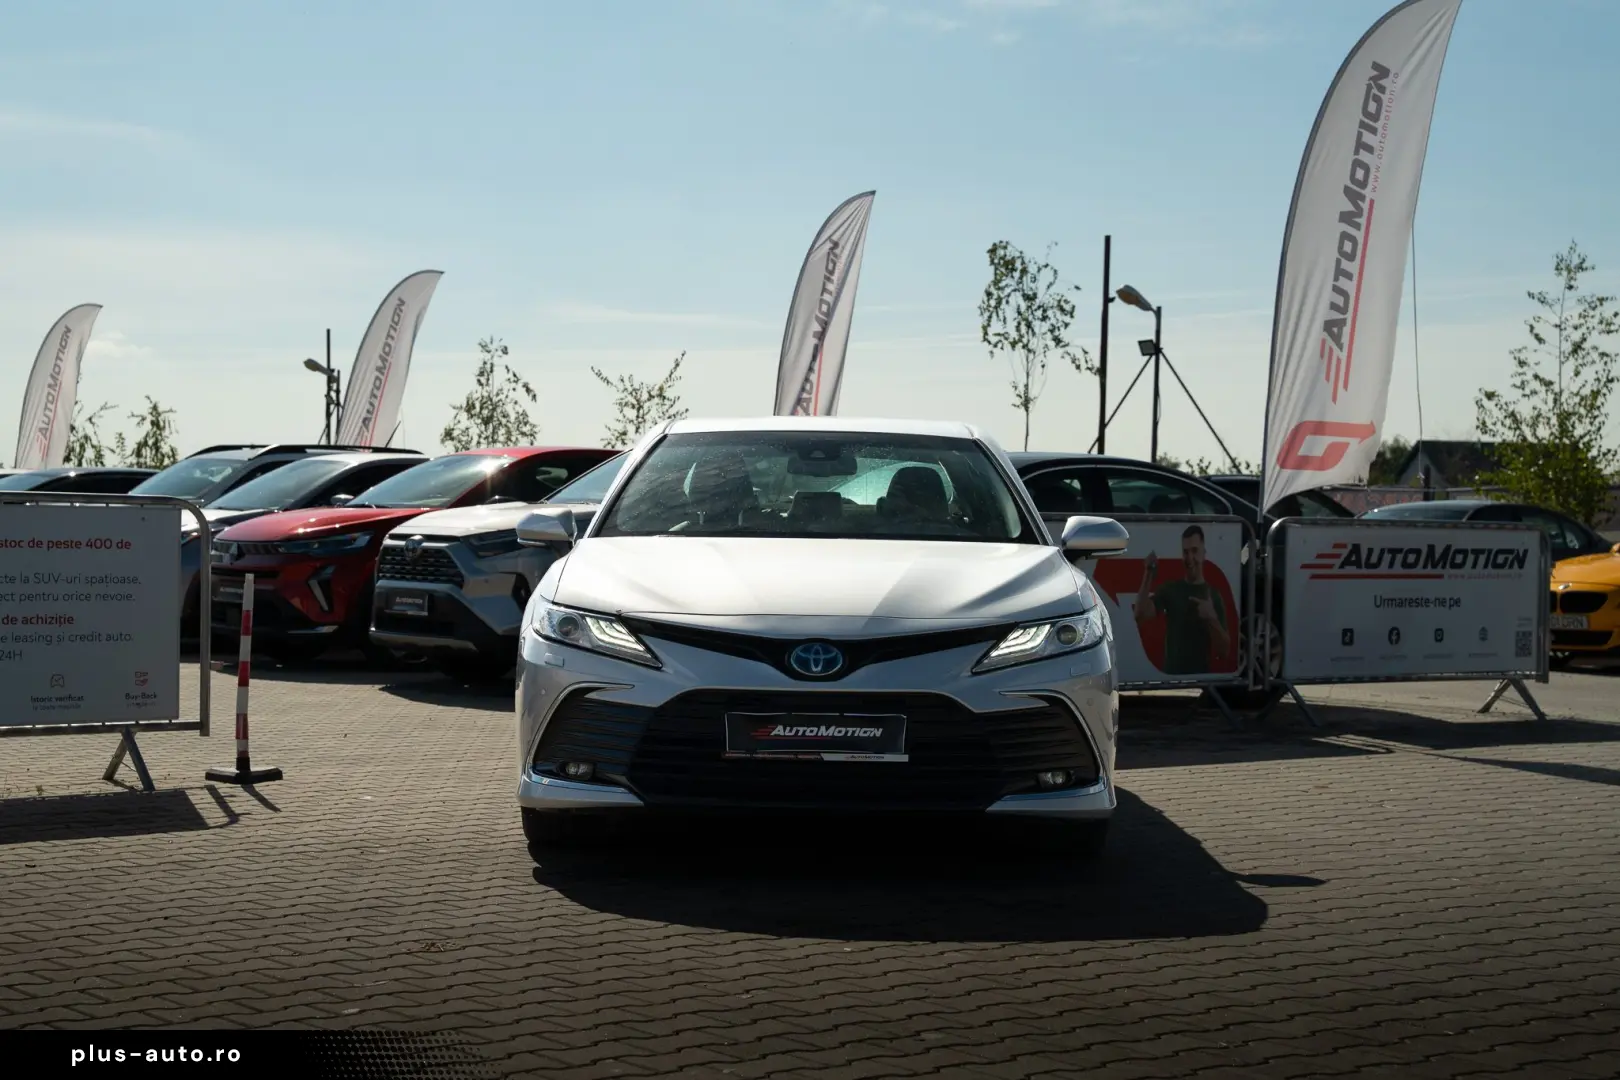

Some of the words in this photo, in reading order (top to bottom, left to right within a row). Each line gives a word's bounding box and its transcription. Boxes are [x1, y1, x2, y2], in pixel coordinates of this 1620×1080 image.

[1370, 71, 1400, 193] www.automotion.ro
[799, 236, 840, 416] AUMOTION
[0, 538, 24, 549] stoc
[27, 537, 43, 549] de
[47, 539, 82, 552] peste
[85, 538, 112, 549] 400
[116, 538, 132, 549] de
[20, 571, 30, 584] la
[33, 572, 81, 584] SUV-uri
[19, 591, 59, 604] pentru
[62, 590, 91, 602] orice
[95, 591, 136, 602] nevoie.
[1449, 597, 1461, 610] pe
[2, 613, 18, 625] de
[22, 613, 75, 628] achiziție
[12, 631, 52, 646] leasing
[68, 631, 102, 643] credit
[0, 650, 23, 661] 24H
[30, 695, 53, 703] Istoric
[124, 692, 157, 701] Buy-Back
